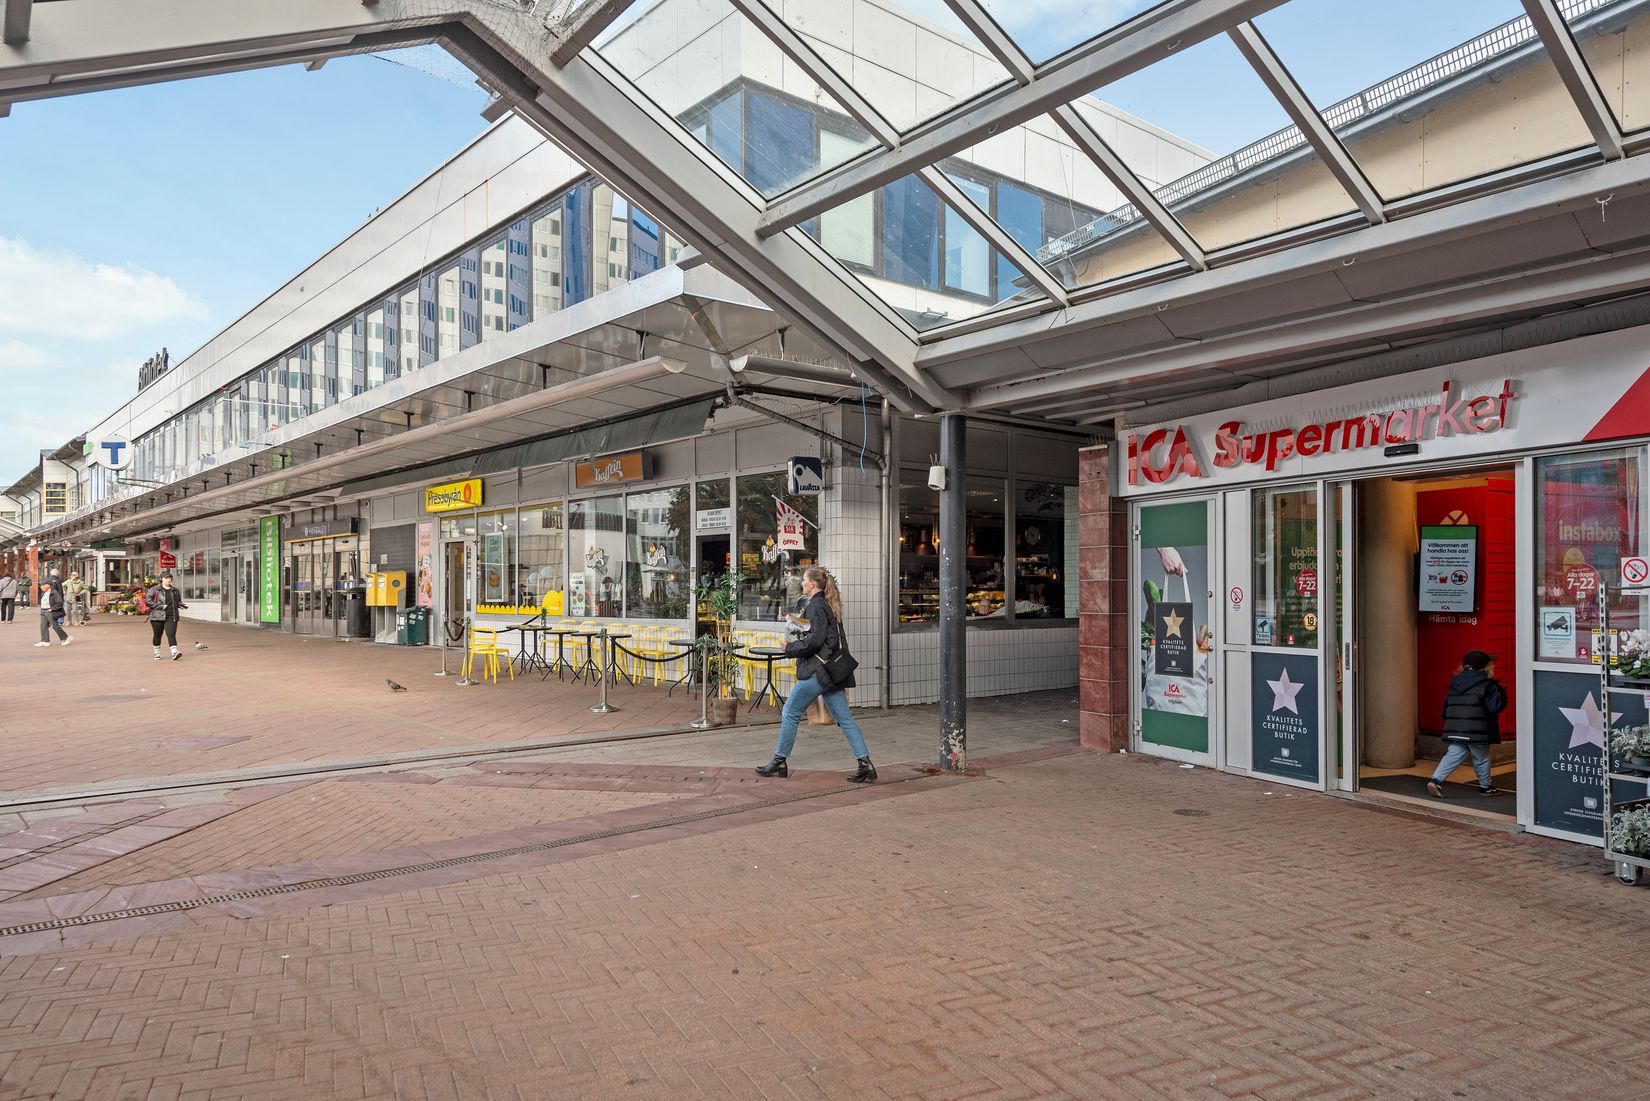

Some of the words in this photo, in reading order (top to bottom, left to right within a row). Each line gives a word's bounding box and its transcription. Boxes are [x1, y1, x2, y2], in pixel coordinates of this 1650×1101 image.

[1127, 424, 1206, 487] ICA
[1213, 378, 1521, 471] Supermarket
[101, 441, 126, 465] T
[1559, 520, 1621, 542] instabox
[782, 538, 799, 546] ÖPPET
[1168, 683, 1180, 693] ICA
[1266, 714, 1303, 726] KVALITETS
[1262, 721, 1308, 734] CERTIFIERAD
[1274, 731, 1295, 741] BUTIK
[1559, 752, 1620, 768] KVALITES
[1551, 761, 1603, 777] CERTIFIE
